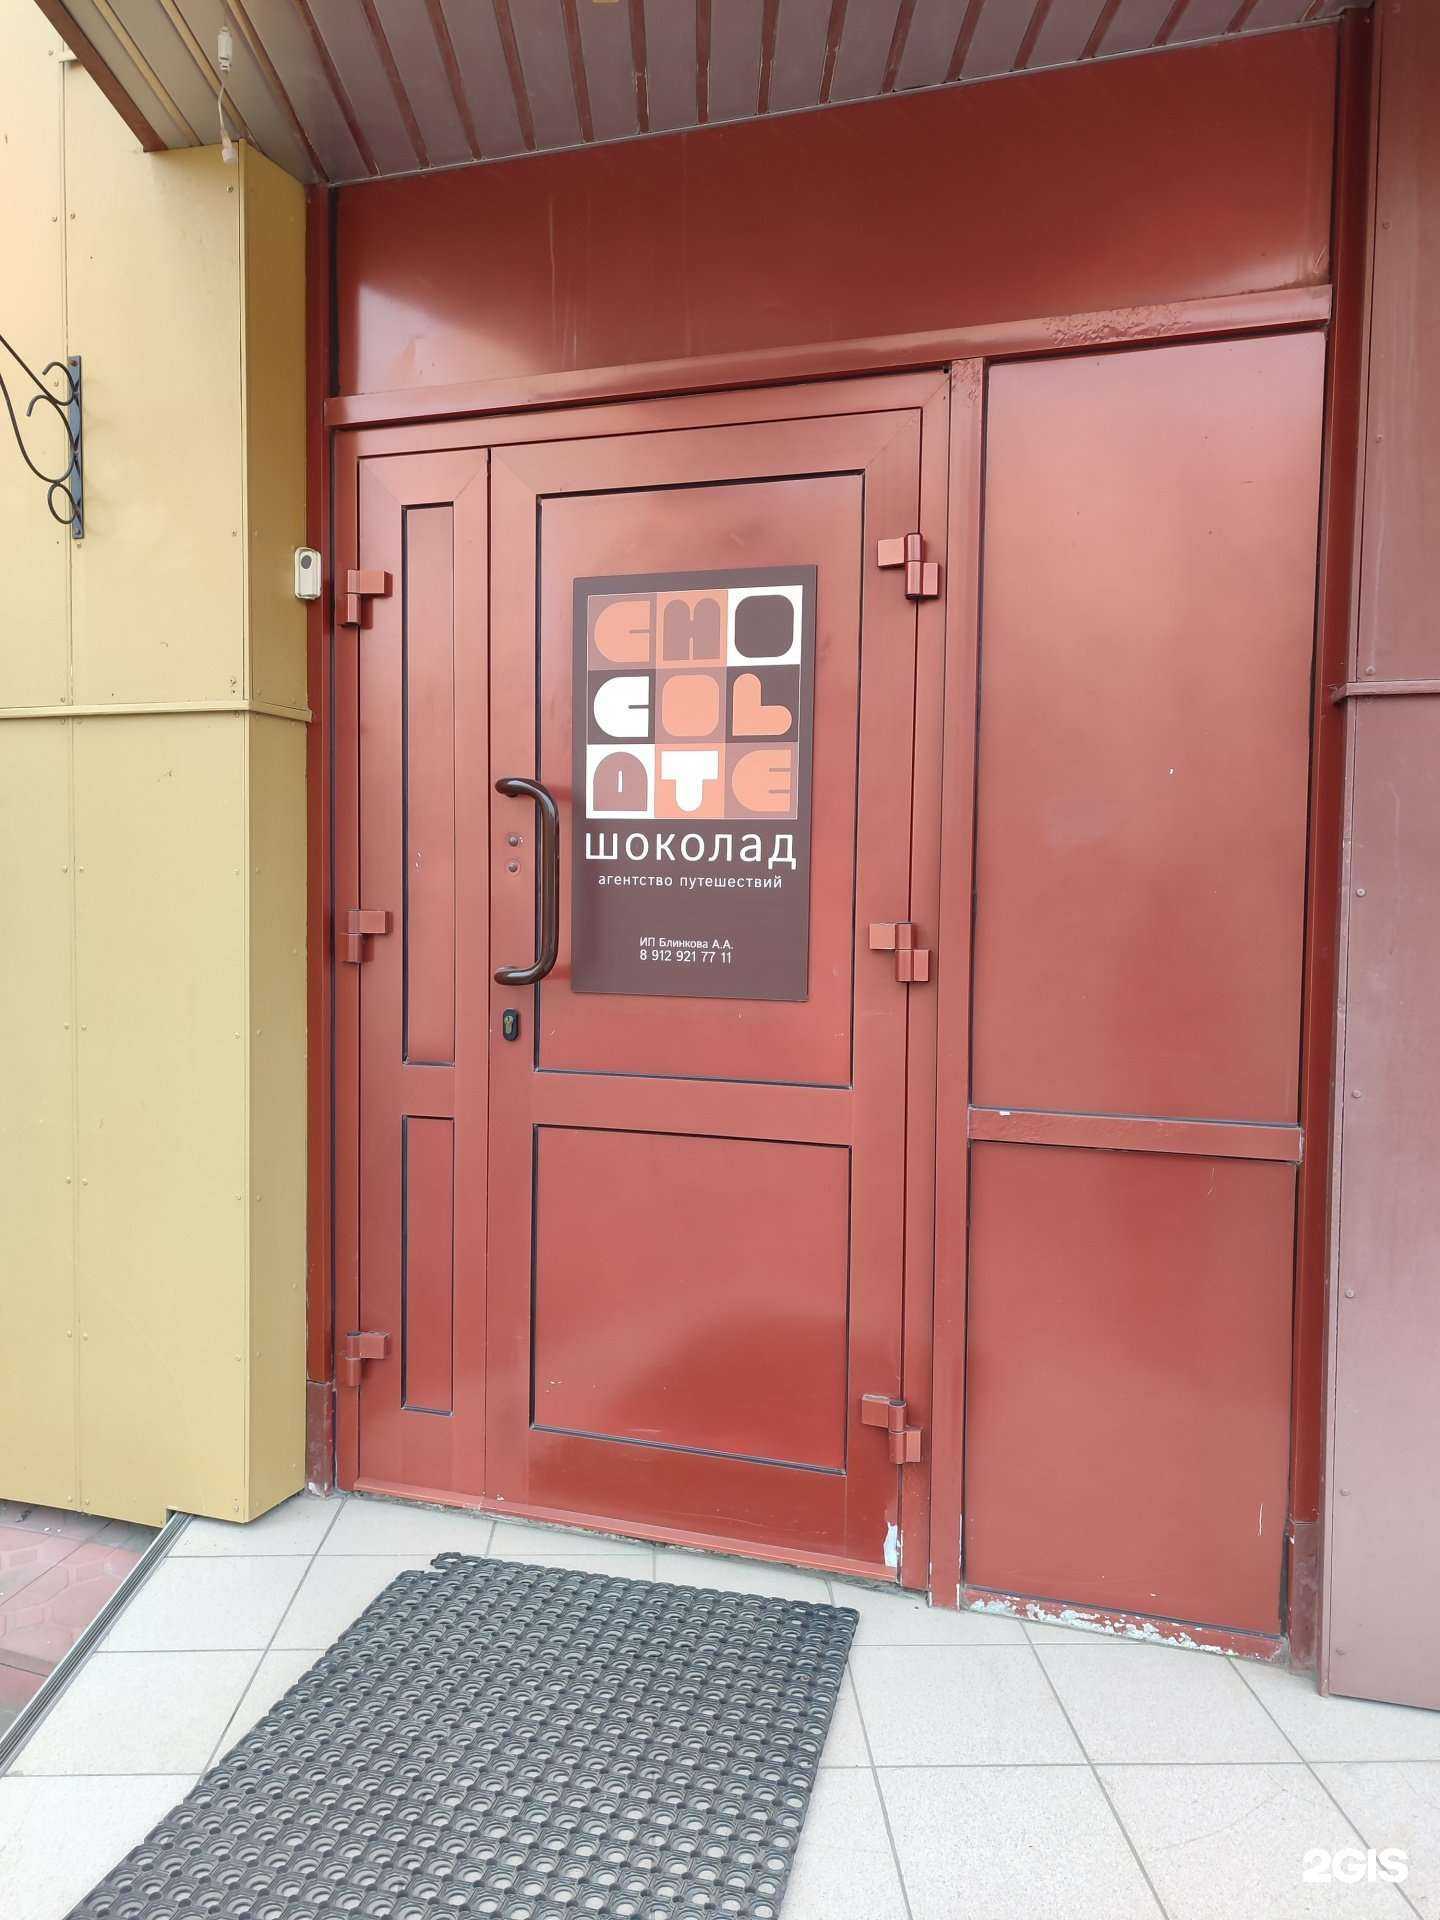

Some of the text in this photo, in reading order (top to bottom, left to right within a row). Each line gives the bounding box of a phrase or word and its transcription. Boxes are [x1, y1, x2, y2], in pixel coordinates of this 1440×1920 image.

[585, 832, 797, 870] шоколад
[598, 874, 783, 890] агентство путешествий
[639, 937, 734, 950] ИП Блинкова А.А.
[639, 950, 732, 964] 8 912 921 77 11
